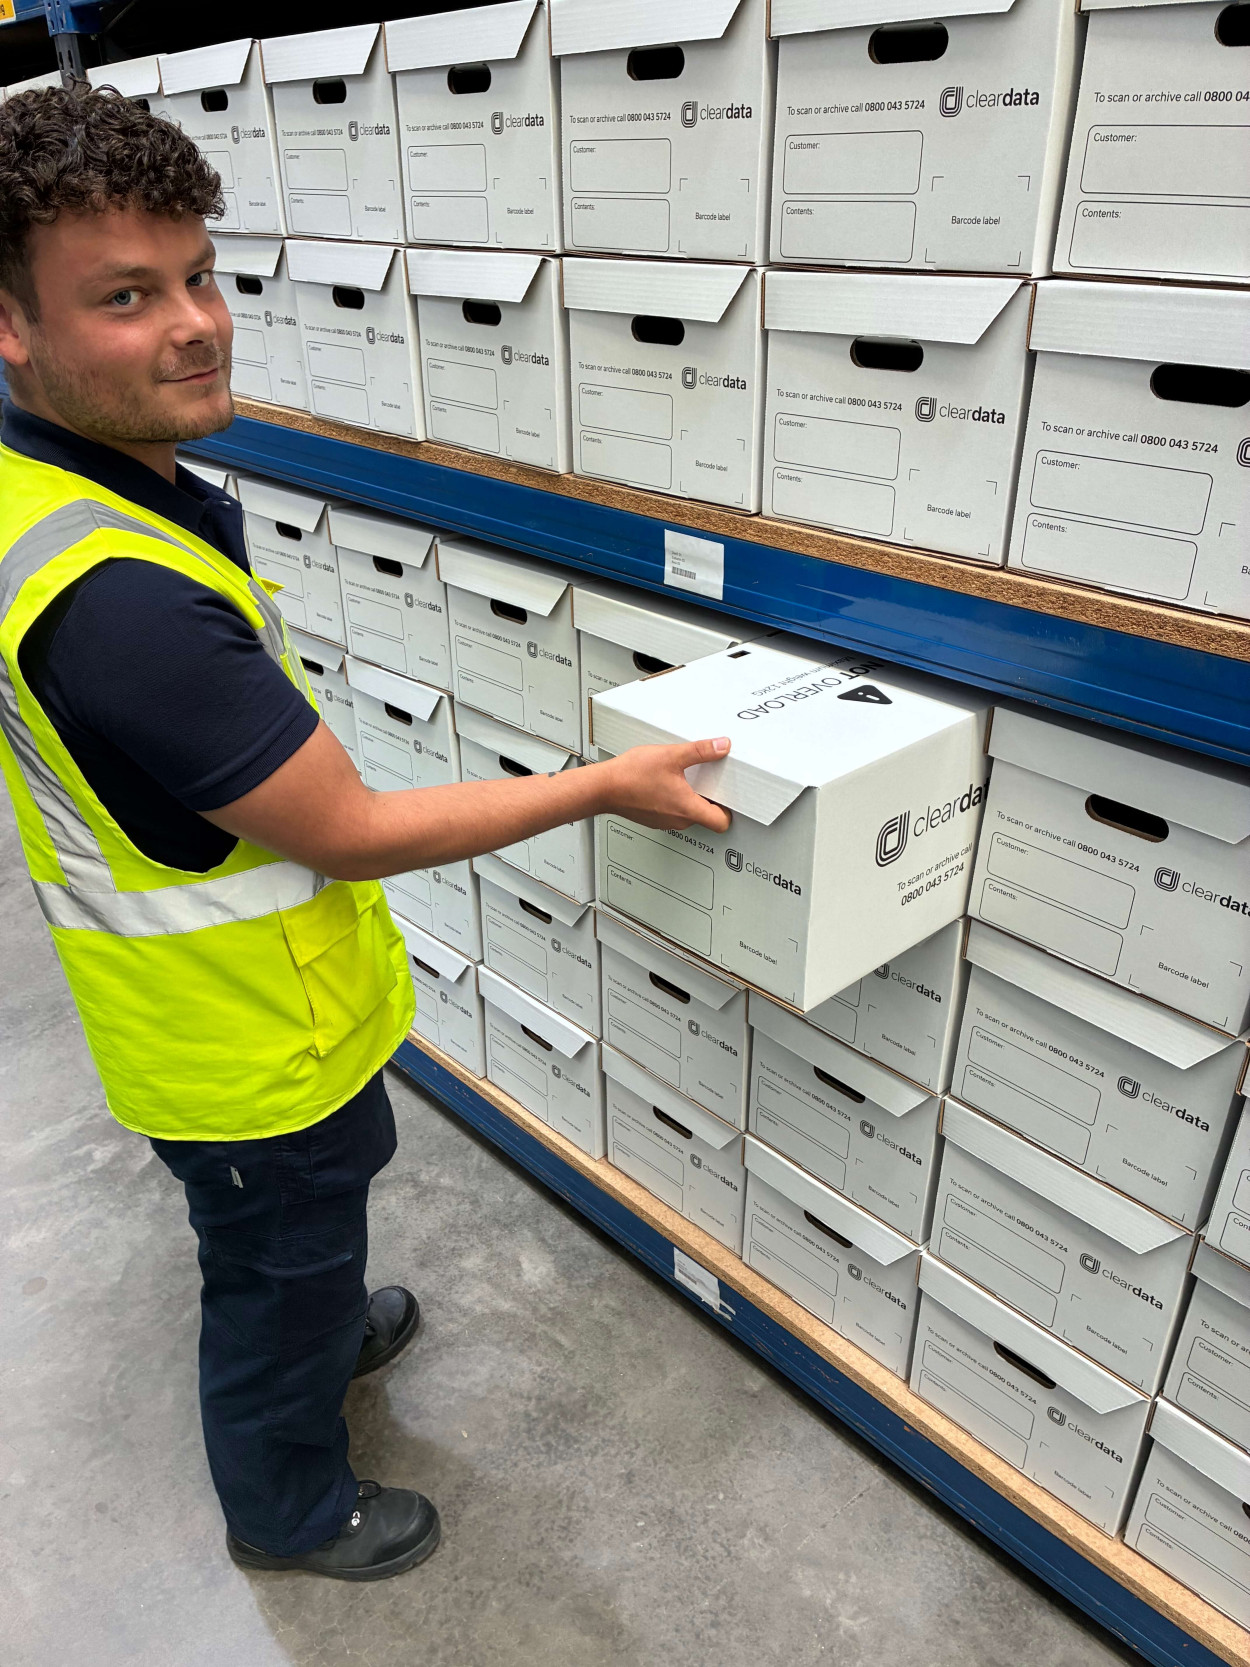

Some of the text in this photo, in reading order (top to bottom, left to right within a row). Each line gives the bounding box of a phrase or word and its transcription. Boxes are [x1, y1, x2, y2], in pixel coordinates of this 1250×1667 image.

[786, 99, 925, 116] To scan or archive call 0800 043 5724
[966, 86, 1040, 109] cleardata
[1094, 92, 1105, 103] To
[1107, 93, 1130, 103] scan
[1132, 93, 1143, 102] or
[1144, 91, 1182, 102] archive
[1184, 91, 1202, 102] call
[1204, 90, 1233, 102] 0800
[505, 112, 545, 128] cleardata
[700, 102, 753, 121] cleardata
[789, 141, 820, 150] Customer:
[1094, 132, 1138, 143] Customer:
[785, 206, 814, 216] Contents:
[951, 215, 1001, 226] Barcode label
[1082, 208, 1122, 219] Contents:
[514, 349, 549, 367] cleardata
[698, 372, 747, 391] cleardata
[776, 388, 785, 397] To
[785, 391, 800, 399] scan
[809, 393, 834, 403] archive
[834, 396, 846, 404] call
[847, 397, 866, 407] 0800
[867, 399, 882, 409] 043
[883, 401, 902, 411] 5724
[778, 417, 807, 428] Customer:
[939, 402, 1006, 425] cleardata
[1041, 421, 1219, 454] To scan or archive call 0800 043 5724
[1040, 456, 1080, 470] Customer:
[776, 471, 803, 483] Contents:
[926, 503, 972, 519] Barcode label
[1031, 518, 1068, 533] Contents:
[539, 648, 572, 668] cleardata
[737, 661, 885, 720] NOT OVERLOAD
[751, 682, 781, 697] 12KG
[778, 672, 809, 687] weight
[610, 825, 635, 842] Customer:
[996, 810, 1140, 872] To scan or archive call 0800 043 5724
[685, 835, 697, 847] 043
[699, 841, 714, 855] 5724
[996, 837, 1029, 855] Customer:
[610, 869, 633, 885] Contents:
[897, 842, 973, 892] To scan or archive call
[745, 862, 802, 896] cleardata
[901, 862, 965, 906] 0800 043 5724
[988, 883, 1018, 900] Contents:
[1182, 882, 1250, 918] cleardat
[739, 940, 778, 965] Barcode label
[1158, 961, 1209, 988] Barcode label
[891, 972, 942, 1004] cleardata
[881, 1033, 917, 1056] Barcode label
[975, 1030, 1005, 1050] Customer:
[975, 1007, 984, 1016] To
[984, 1013, 1000, 1025] scan
[1009, 1026, 1035, 1042] archive
[1035, 1039, 1048, 1049] call
[1048, 1045, 1068, 1059] 0800
[1068, 1055, 1084, 1067] 043
[1085, 1063, 1105, 1078] 5724
[968, 1069, 996, 1088] Contents:
[1141, 1092, 1209, 1132] cleardata
[876, 1133, 923, 1166] cleardata
[1122, 1157, 1168, 1186] Barcode label
[949, 1177, 957, 1186] To
[957, 1184, 972, 1196] scan
[980, 1198, 1004, 1214] archive
[1004, 1212, 1016, 1221] call
[1016, 1218, 1034, 1232] 0800
[1035, 1229, 1049, 1241] 043
[1049, 1238, 1068, 1253] 5724
[950, 1198, 977, 1218] Customer:
[945, 1231, 970, 1250] Contents:
[863, 1277, 906, 1310] cleardata
[1102, 1269, 1164, 1311] cleardata
[1086, 1325, 1128, 1355] Barcode label
[1200, 1318, 1241, 1347] To scan or
[927, 1325, 934, 1334] To
[934, 1332, 948, 1344] scan
[956, 1347, 977, 1364] archive
[978, 1362, 989, 1371] call
[989, 1369, 1006, 1383] 0800
[1006, 1381, 1019, 1392] 043
[1020, 1390, 1037, 1404] 5724
[1198, 1341, 1234, 1367] Customer:
[1187, 1377, 1220, 1401] Contents:
[1067, 1422, 1123, 1465] cleardata
[1154, 1497, 1187, 1522] Customer:
[1156, 1478, 1165, 1488] To
[1165, 1486, 1183, 1500] scan
[1183, 1497, 1192, 1506] or
[1192, 1503, 1219, 1524] archive
[1219, 1521, 1233, 1533] call
[1145, 1528, 1174, 1550] Contents:
